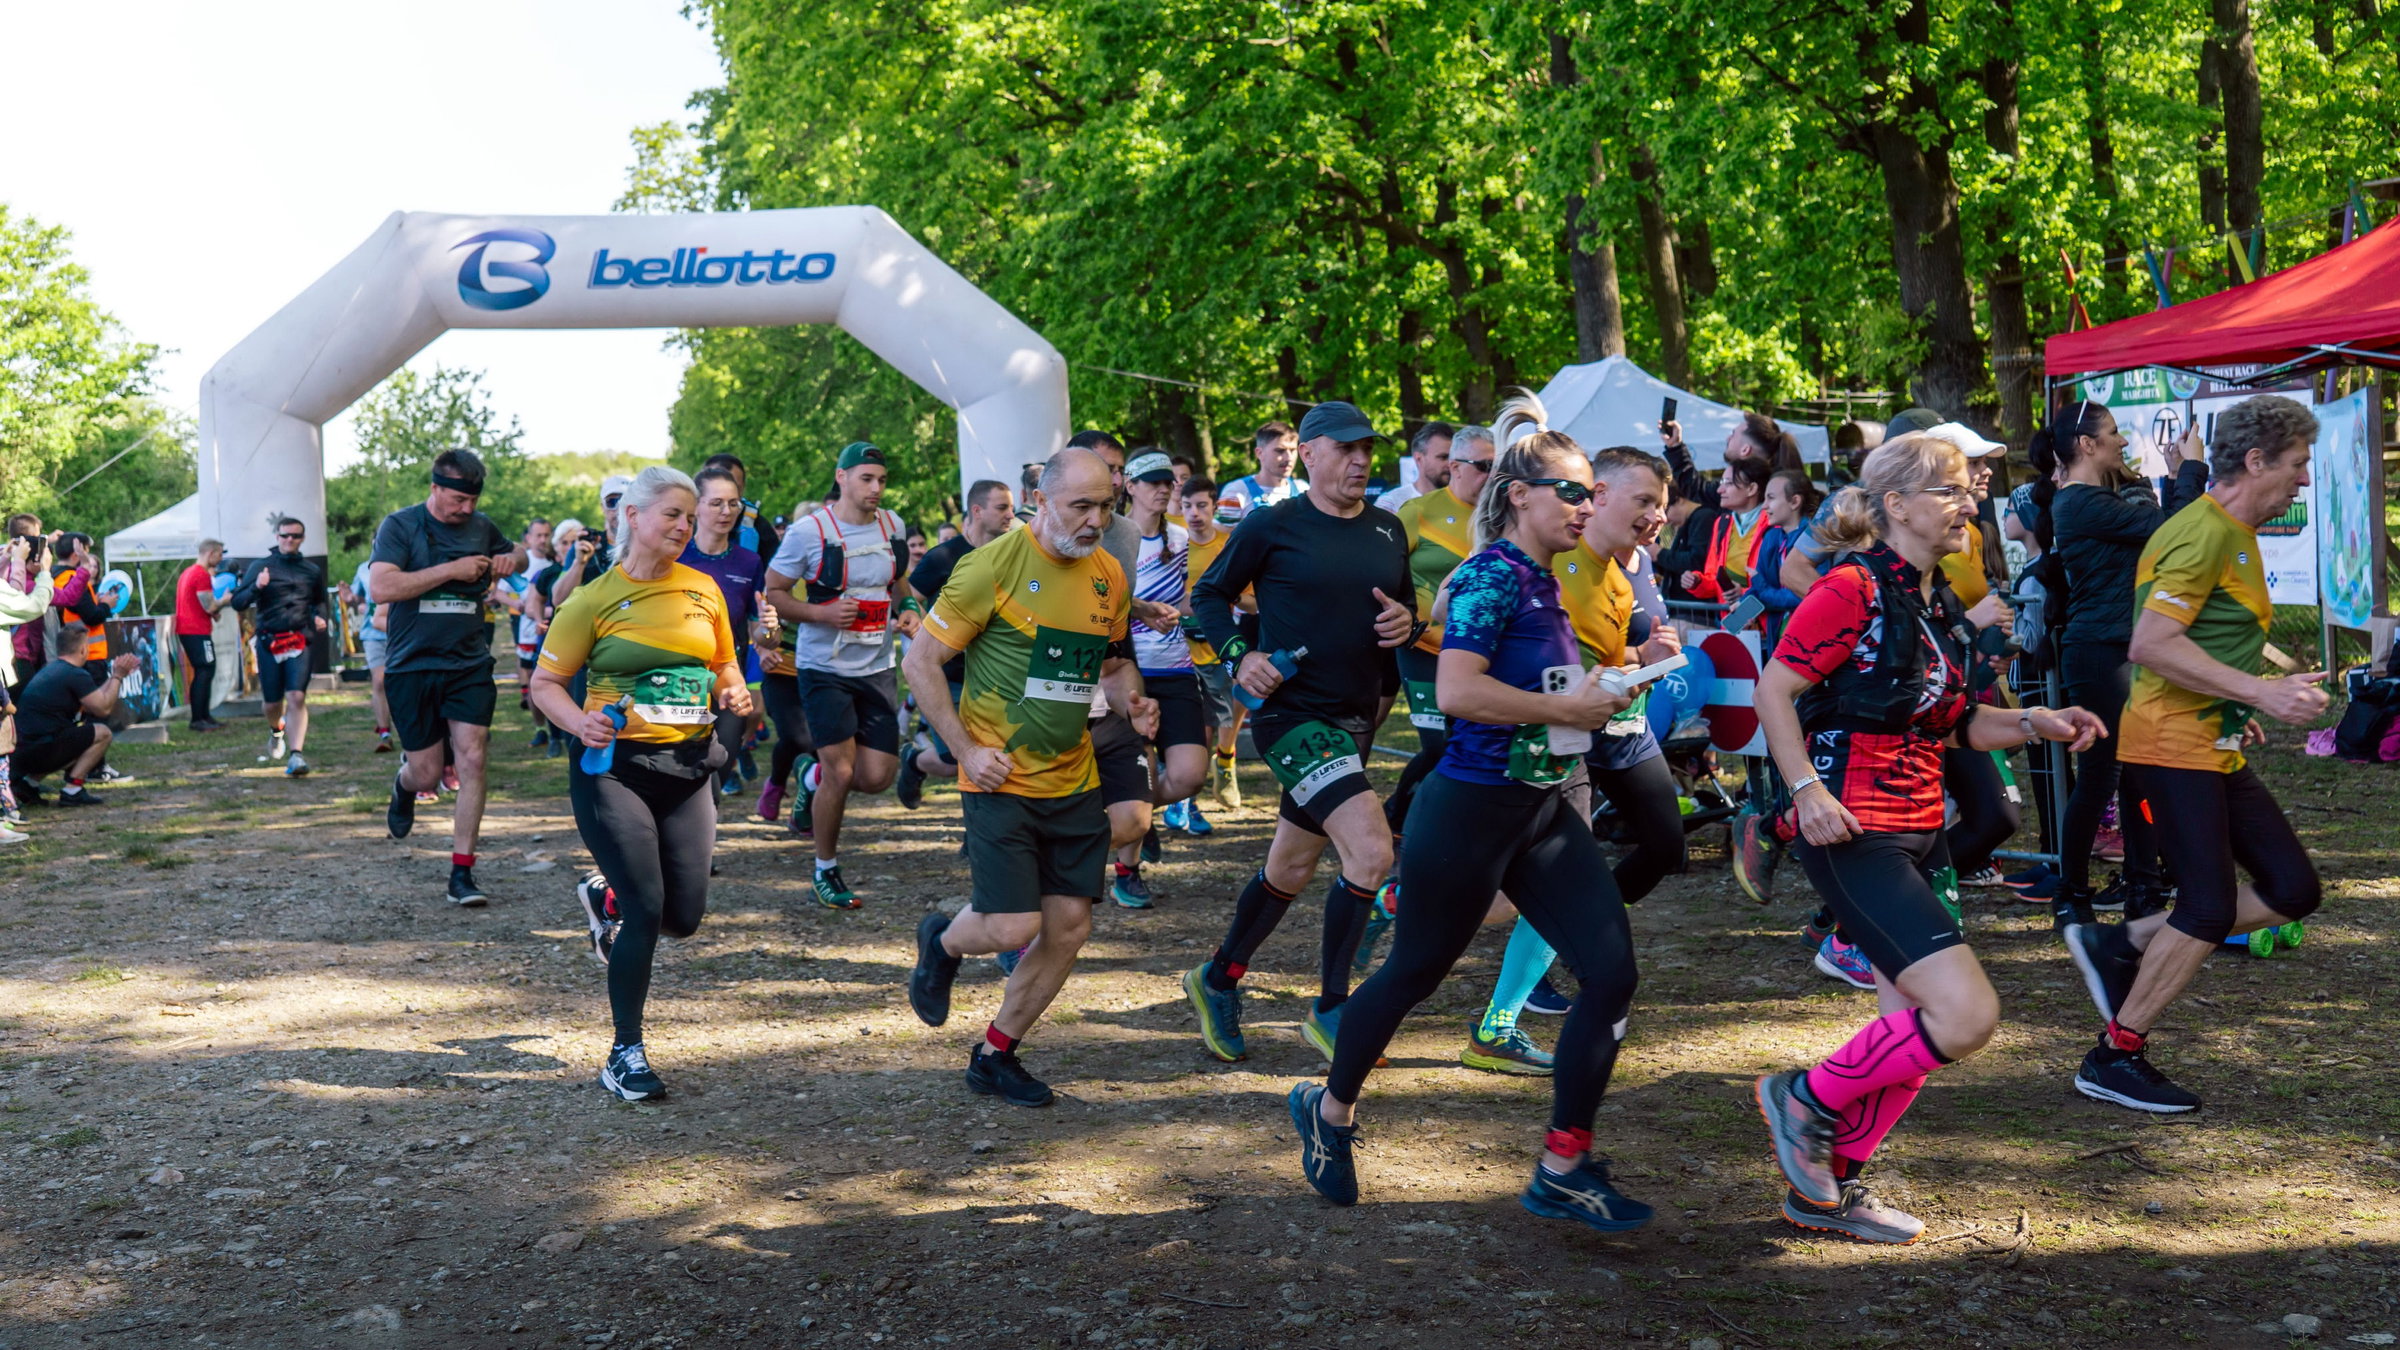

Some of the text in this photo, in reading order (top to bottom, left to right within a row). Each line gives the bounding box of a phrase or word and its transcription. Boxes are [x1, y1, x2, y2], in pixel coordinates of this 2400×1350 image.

[588, 246, 837, 290] bellotto
[2124, 368, 2157, 388] RACE
[2235, 364, 2257, 377] RACE
[1299, 728, 1346, 758] 135
[1319, 758, 1349, 776] LIFETEC
